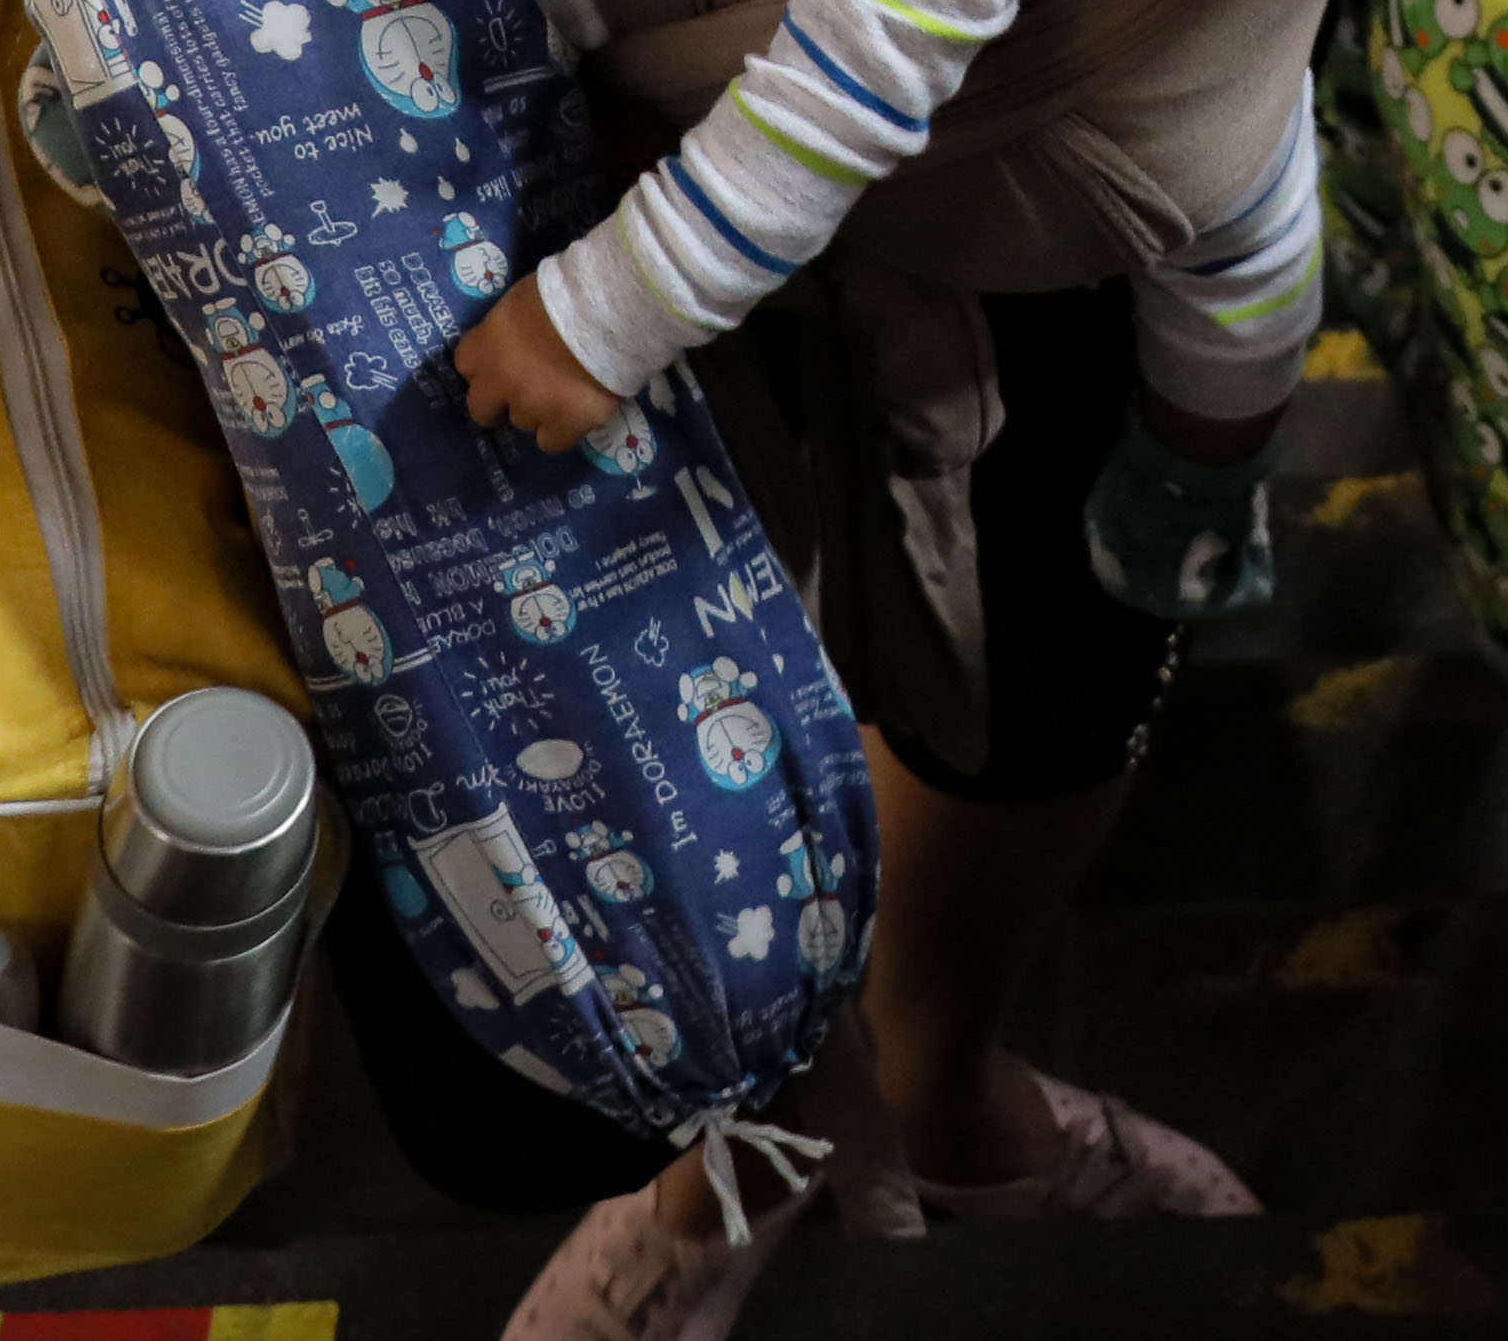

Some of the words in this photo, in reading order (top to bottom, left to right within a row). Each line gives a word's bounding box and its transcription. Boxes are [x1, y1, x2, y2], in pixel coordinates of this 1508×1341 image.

[186, 8, 229, 68] gadgets
[192, 57, 225, 108] carries
[222, 70, 249, 112] fancy
[219, 109, 244, 145] that
[248, 114, 296, 145] you.
[302, 102, 363, 135] meet
[293, 141, 319, 160] to
[324, 122, 374, 152] Nice
[237, 146, 275, 198] pocket
[480, 666, 520, 696] you!
[482, 687, 546, 720] Thank
[579, 642, 678, 805] DORAEMON
[542, 788, 595, 813] LOVE
